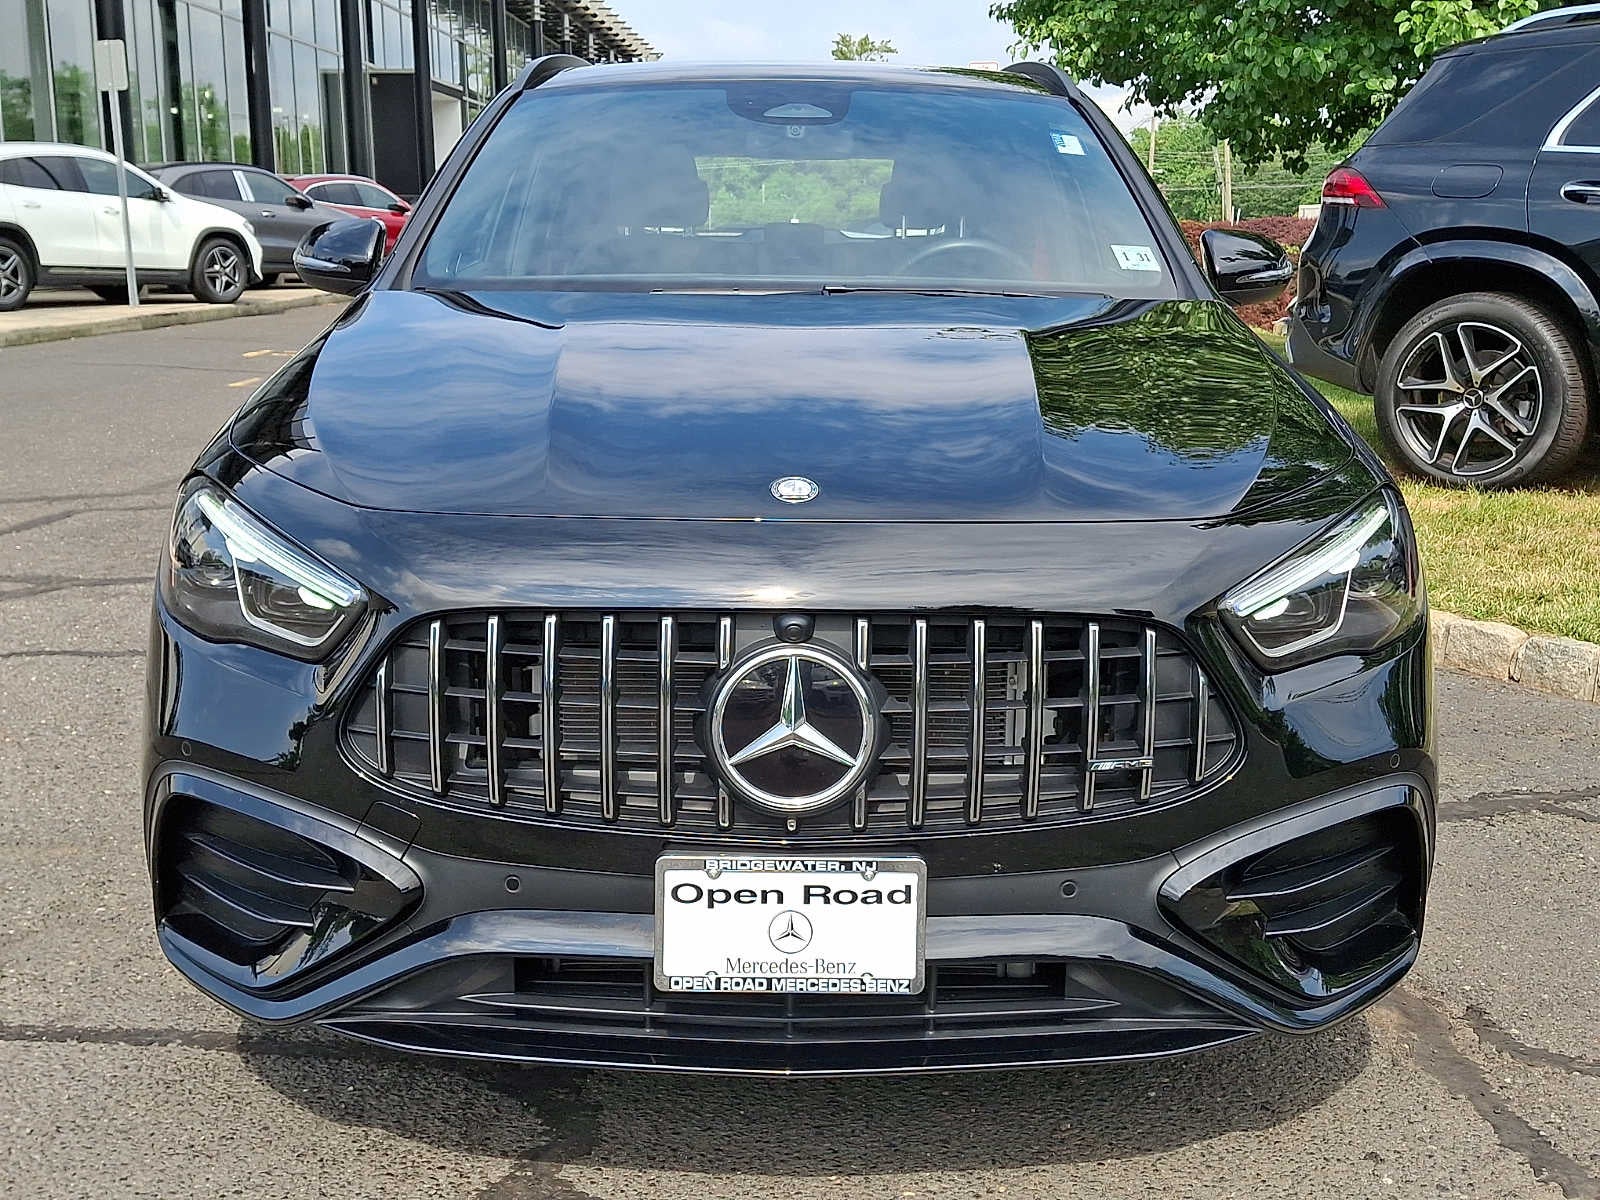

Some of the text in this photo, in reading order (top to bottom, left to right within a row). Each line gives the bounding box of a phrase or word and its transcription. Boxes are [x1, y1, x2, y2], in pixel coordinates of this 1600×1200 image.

[705, 859, 878, 873] BRIDGEWATER, NJ
[671, 883, 912, 909] Open Road
[725, 957, 857, 975] Mercedes-Benz
[670, 976, 716, 990] OPEN
[720, 977, 768, 991] ROAD
